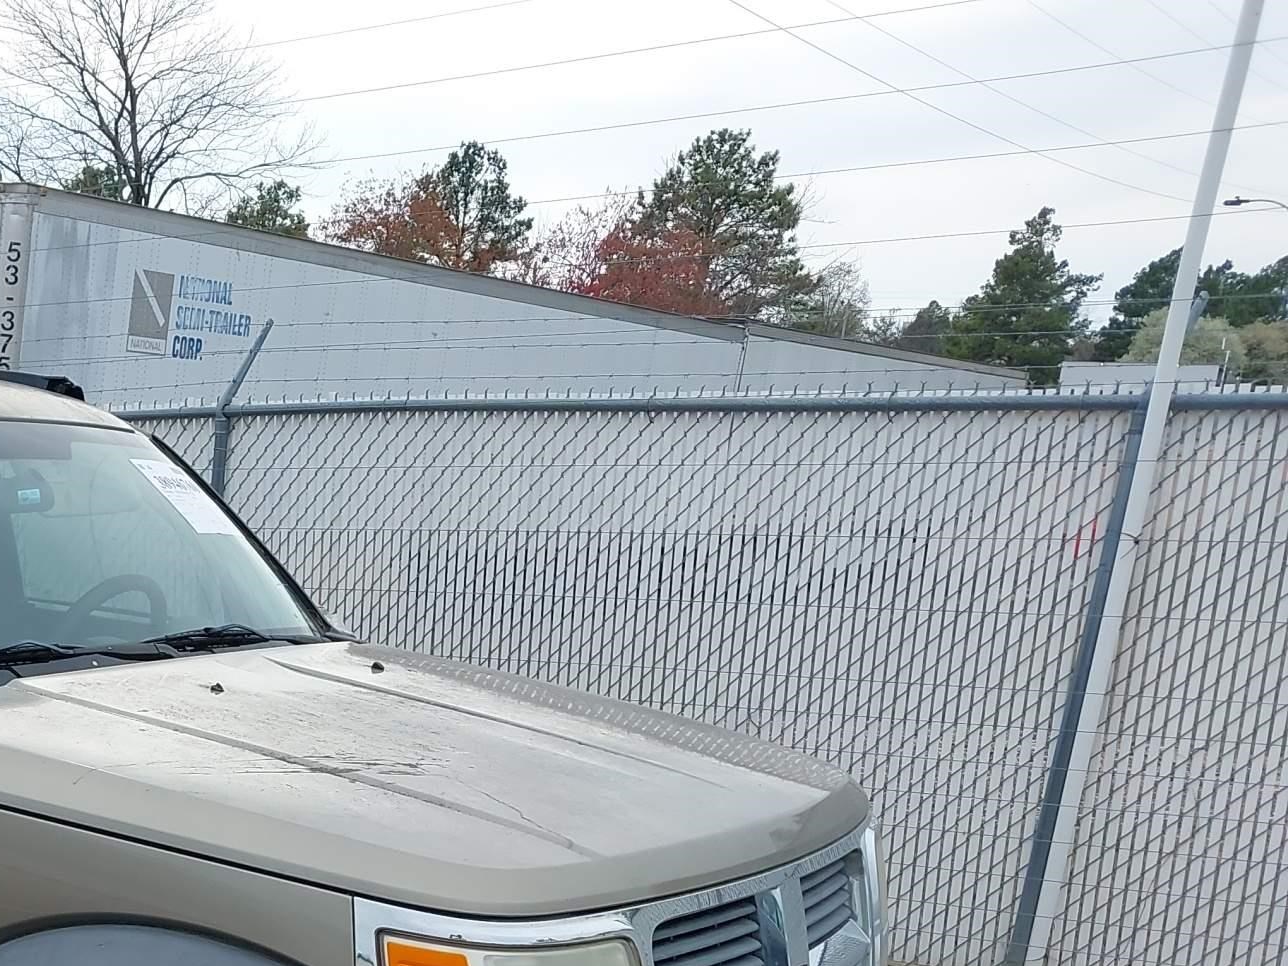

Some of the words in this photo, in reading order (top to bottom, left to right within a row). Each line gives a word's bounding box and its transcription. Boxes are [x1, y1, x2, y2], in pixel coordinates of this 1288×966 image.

[178, 274, 234, 306] NATIONAL
[175, 304, 252, 338] SEMI-TRAILER
[130, 337, 162, 352] NATIONAL
[171, 335, 203, 361] CORP.
